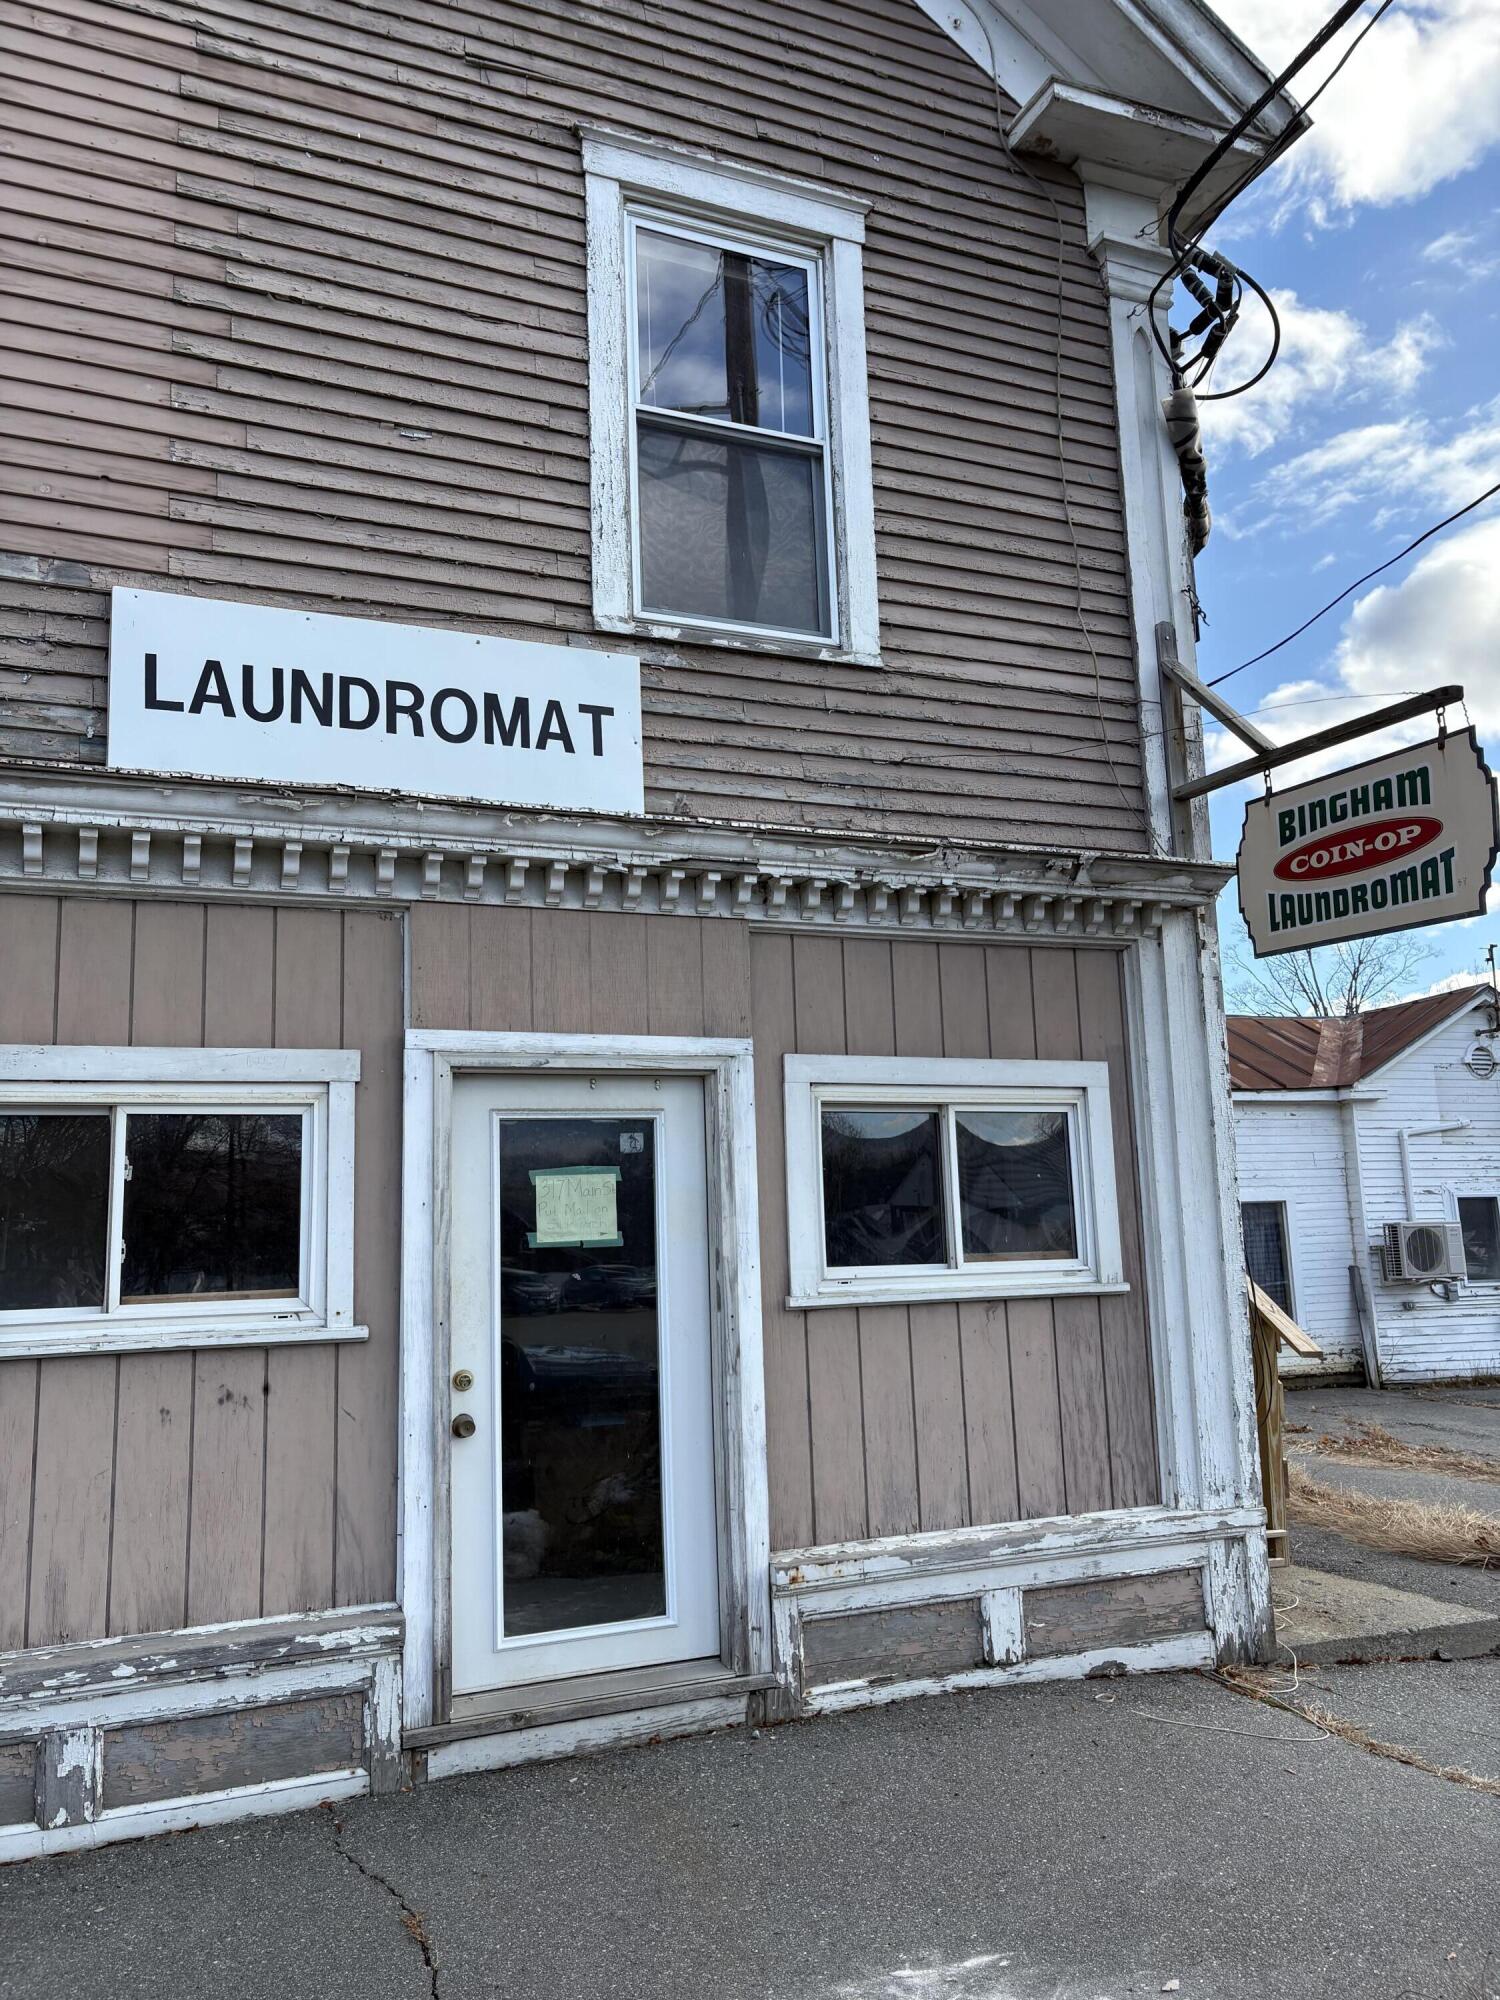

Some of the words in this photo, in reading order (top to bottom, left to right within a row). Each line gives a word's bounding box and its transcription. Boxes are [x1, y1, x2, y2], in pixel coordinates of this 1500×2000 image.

[144, 652, 615, 757] LAUNDROMAT
[1278, 765, 1431, 847] BINGHAM
[1268, 846, 1455, 932] LAUNDROMAT
[1289, 824, 1422, 874] COIN-OP
[540, 1177, 564, 1200] 317
[566, 1176, 602, 1198] Main
